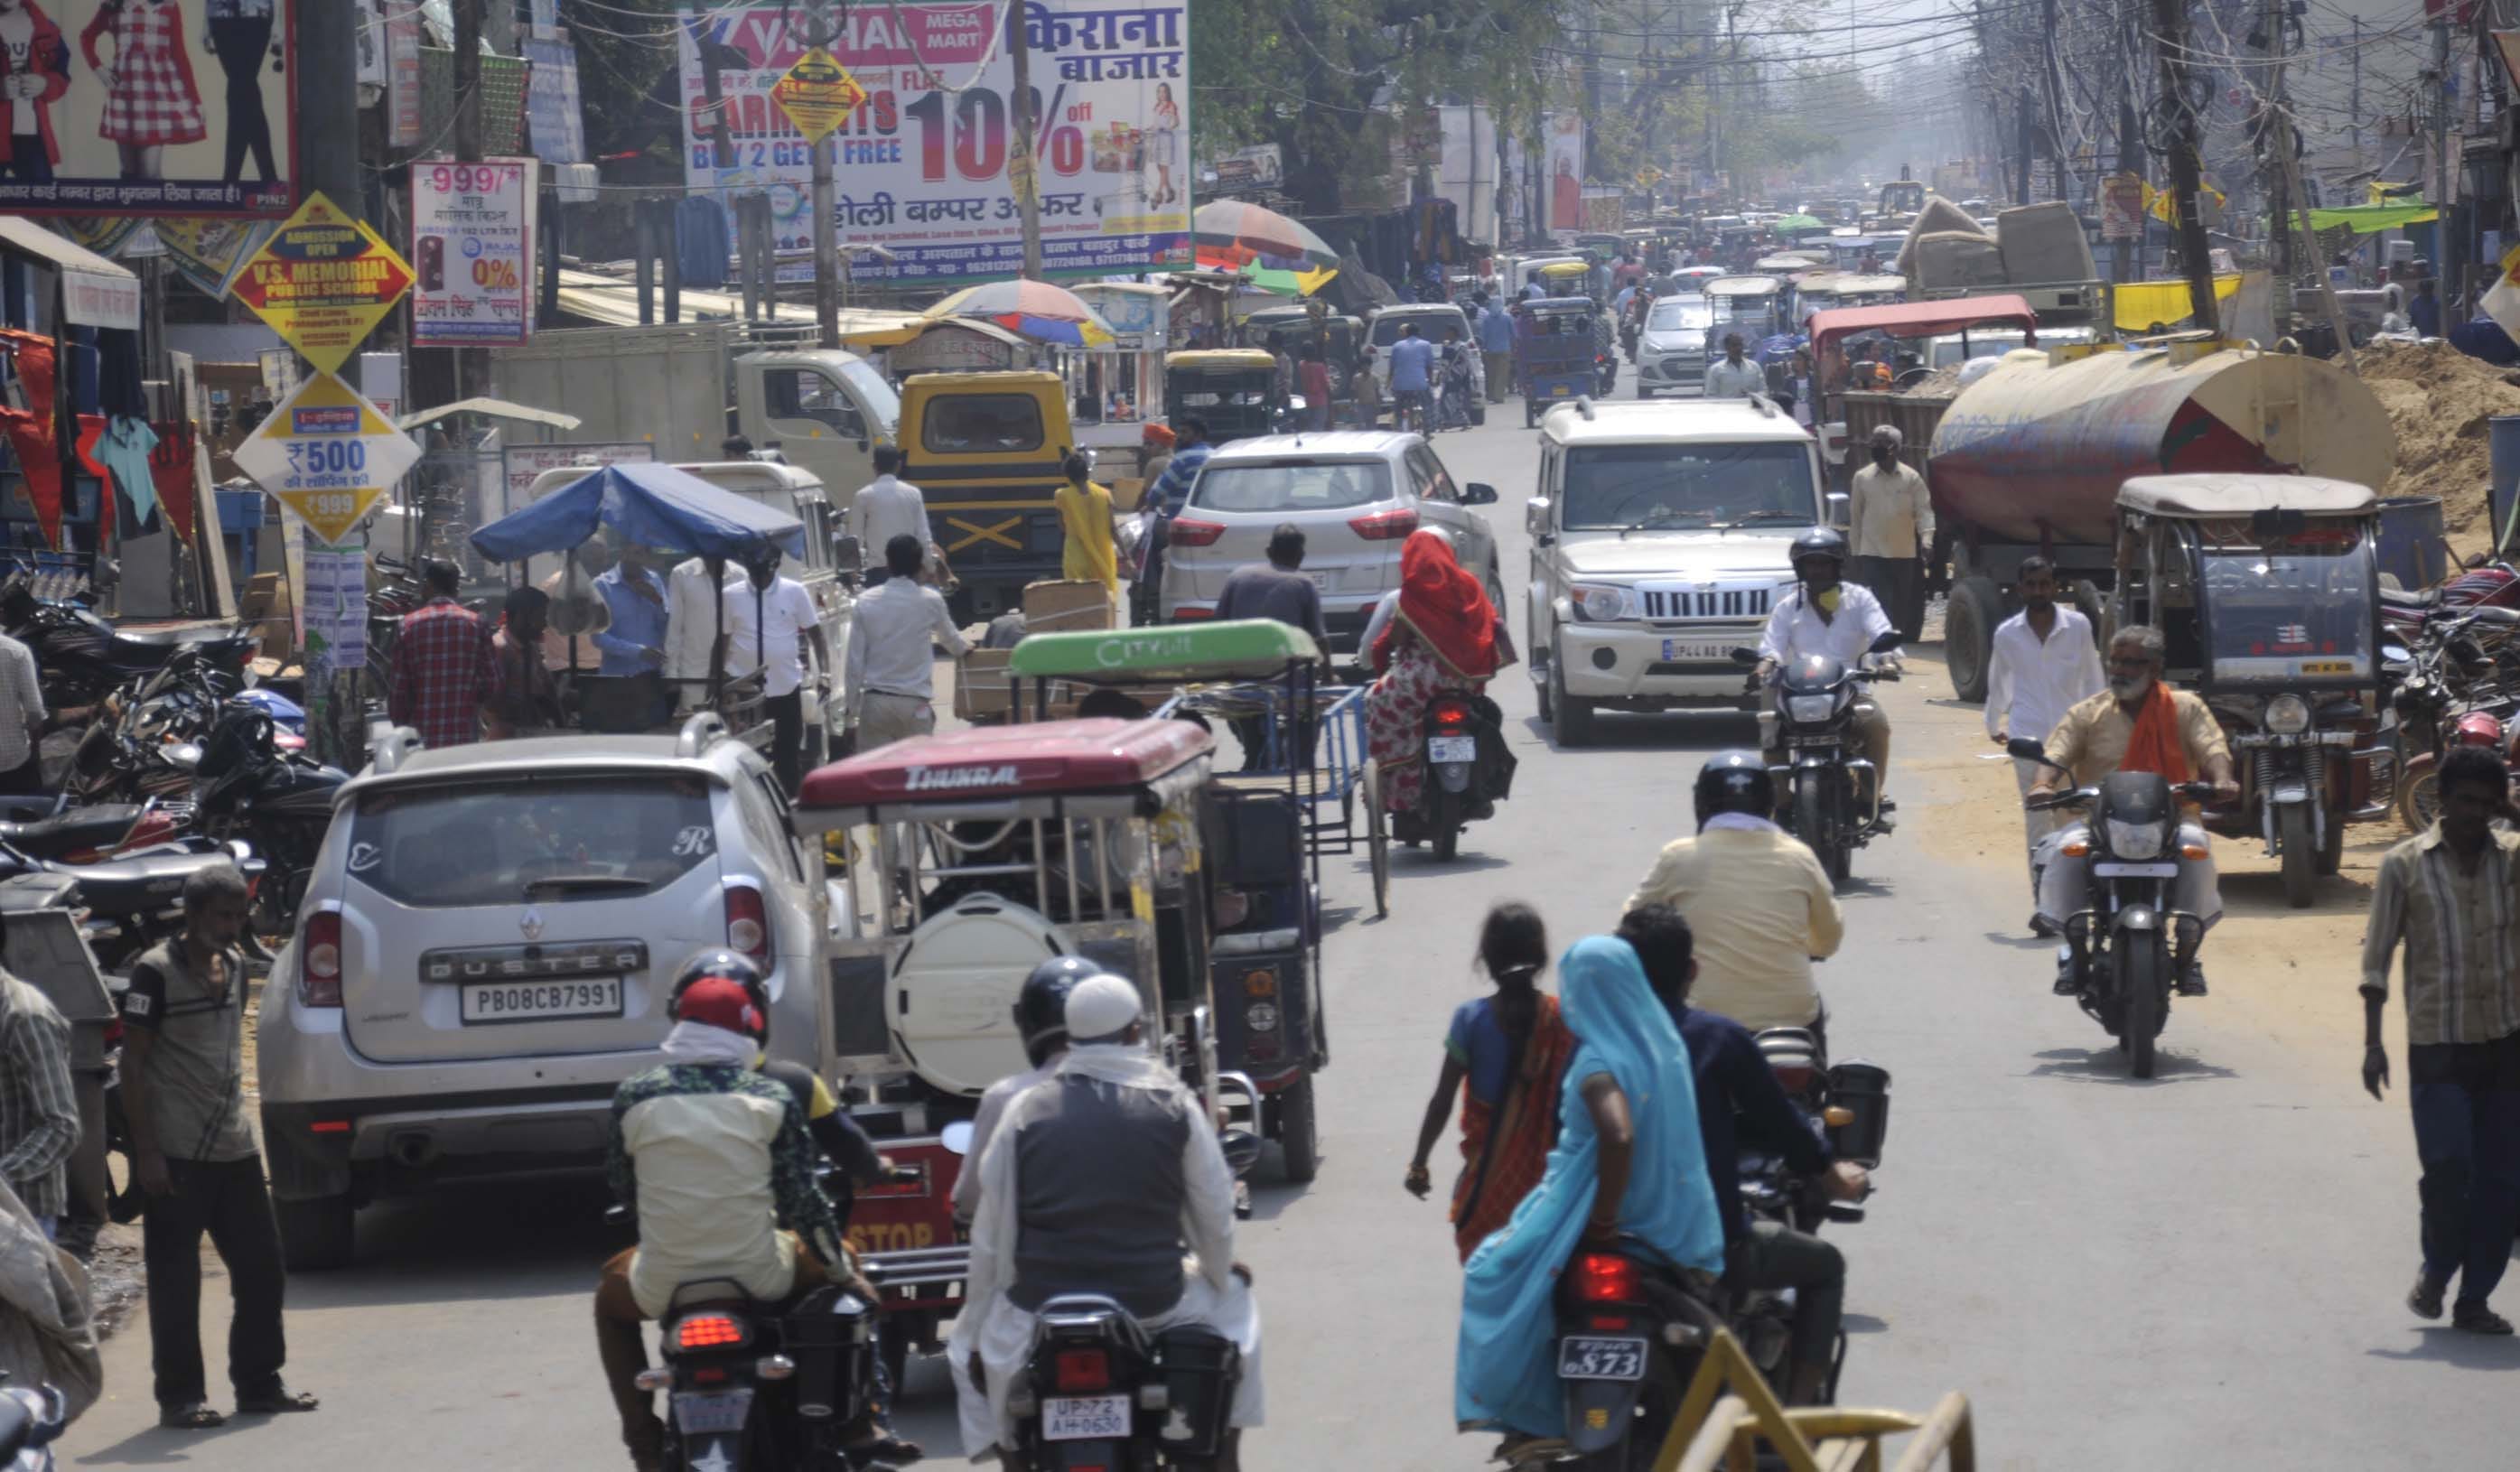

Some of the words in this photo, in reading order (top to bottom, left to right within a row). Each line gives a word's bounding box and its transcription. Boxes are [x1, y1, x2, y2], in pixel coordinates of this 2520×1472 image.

[926, 14, 980, 29] MEGA
[1005, 1, 1184, 55] किराना
[927, 33, 979, 49] MART
[1055, 51, 1184, 82] बाजार
[901, 70, 946, 91] FLAT
[904, 83, 1084, 183] 10%
[1067, 102, 1094, 123] off
[751, 142, 766, 168] 2
[844, 138, 902, 165] FREE
[904, 198, 988, 223] बम्पर
[285, 229, 356, 245] ADMISSION
[305, 244, 339, 256] OPEN
[253, 263, 288, 284] V.S.
[292, 260, 390, 283] MEMORIAL
[471, 258, 521, 290] 0%
[266, 283, 319, 298] PUBLIC
[322, 282, 379, 295] SCHOOL
[904, 765, 1022, 791] THUKRAL
[429, 953, 638, 978] DUSTER
[477, 983, 619, 1013] PB08CB7991
[851, 1222, 934, 1253] STOP
